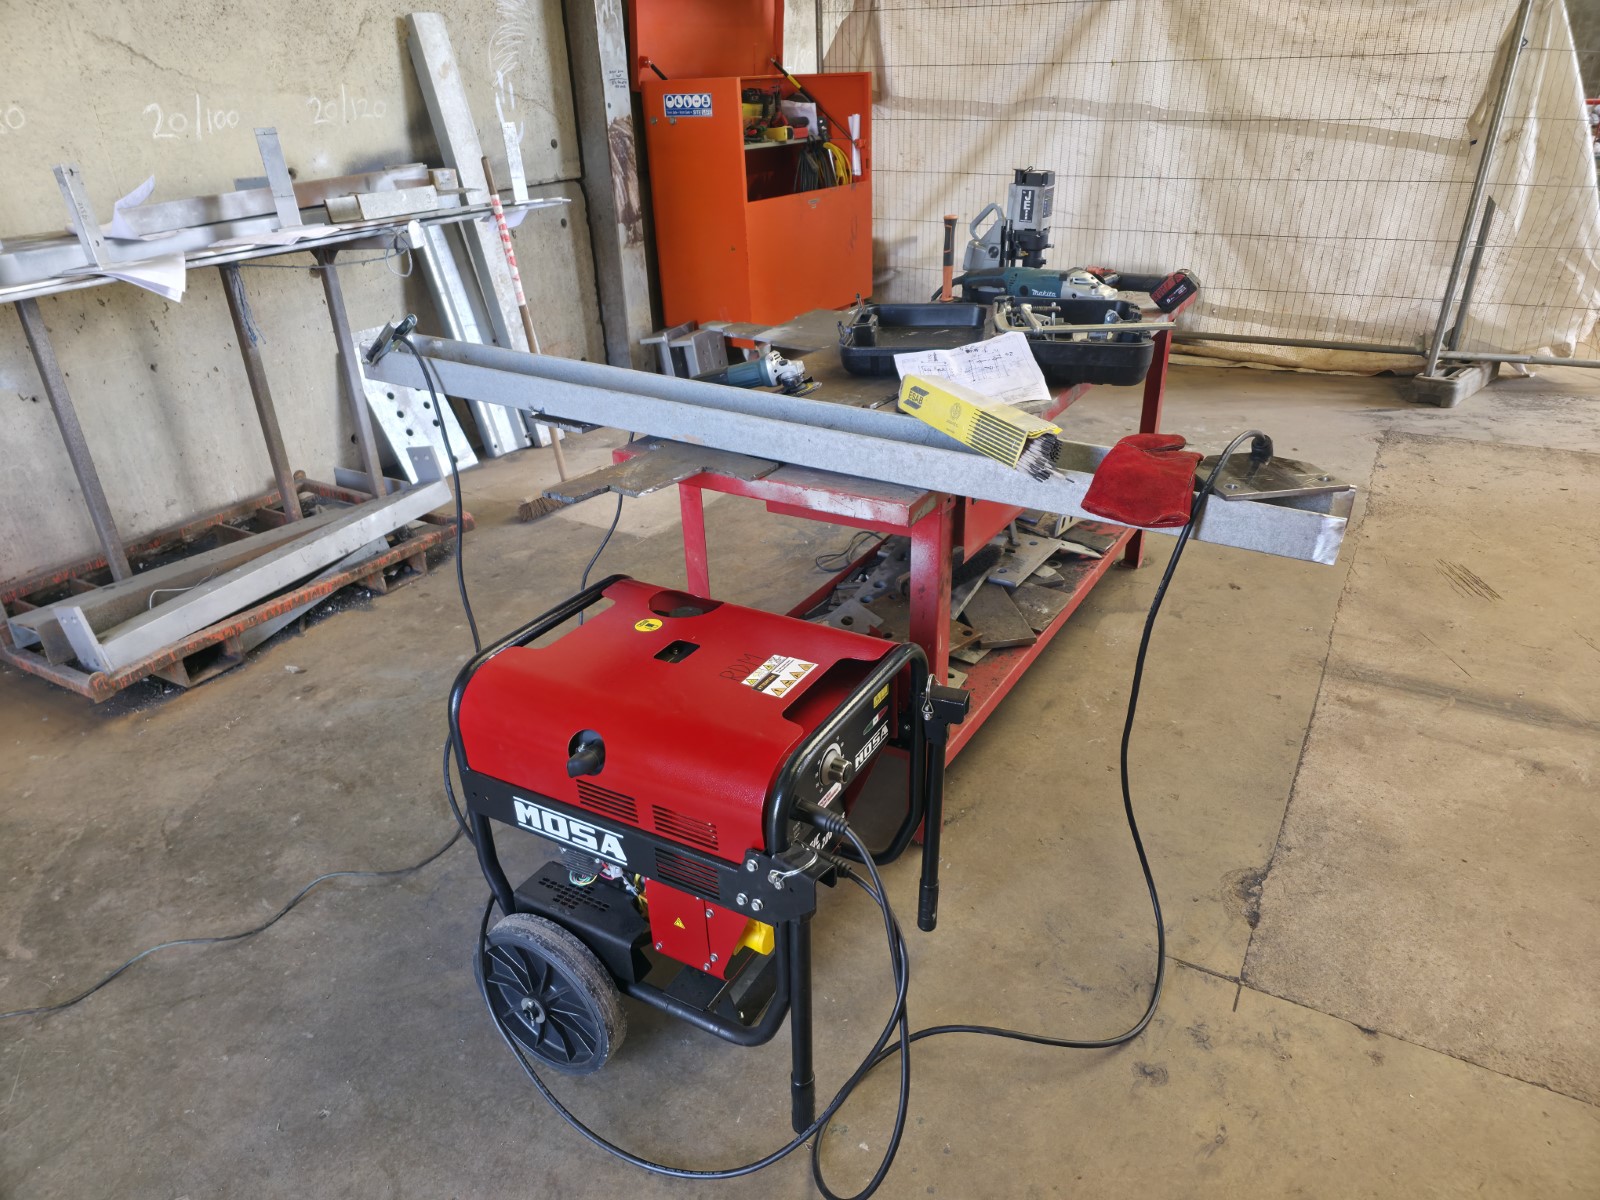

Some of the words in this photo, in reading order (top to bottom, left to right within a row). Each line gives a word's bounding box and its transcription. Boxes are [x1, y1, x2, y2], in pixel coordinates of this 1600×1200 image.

[143, 93, 239, 140] 20/100
[306, 83, 387, 127] 20/120
[907, 390, 924, 405] ESAB
[854, 724, 889, 770] MOSA
[513, 800, 628, 862] MOSA
